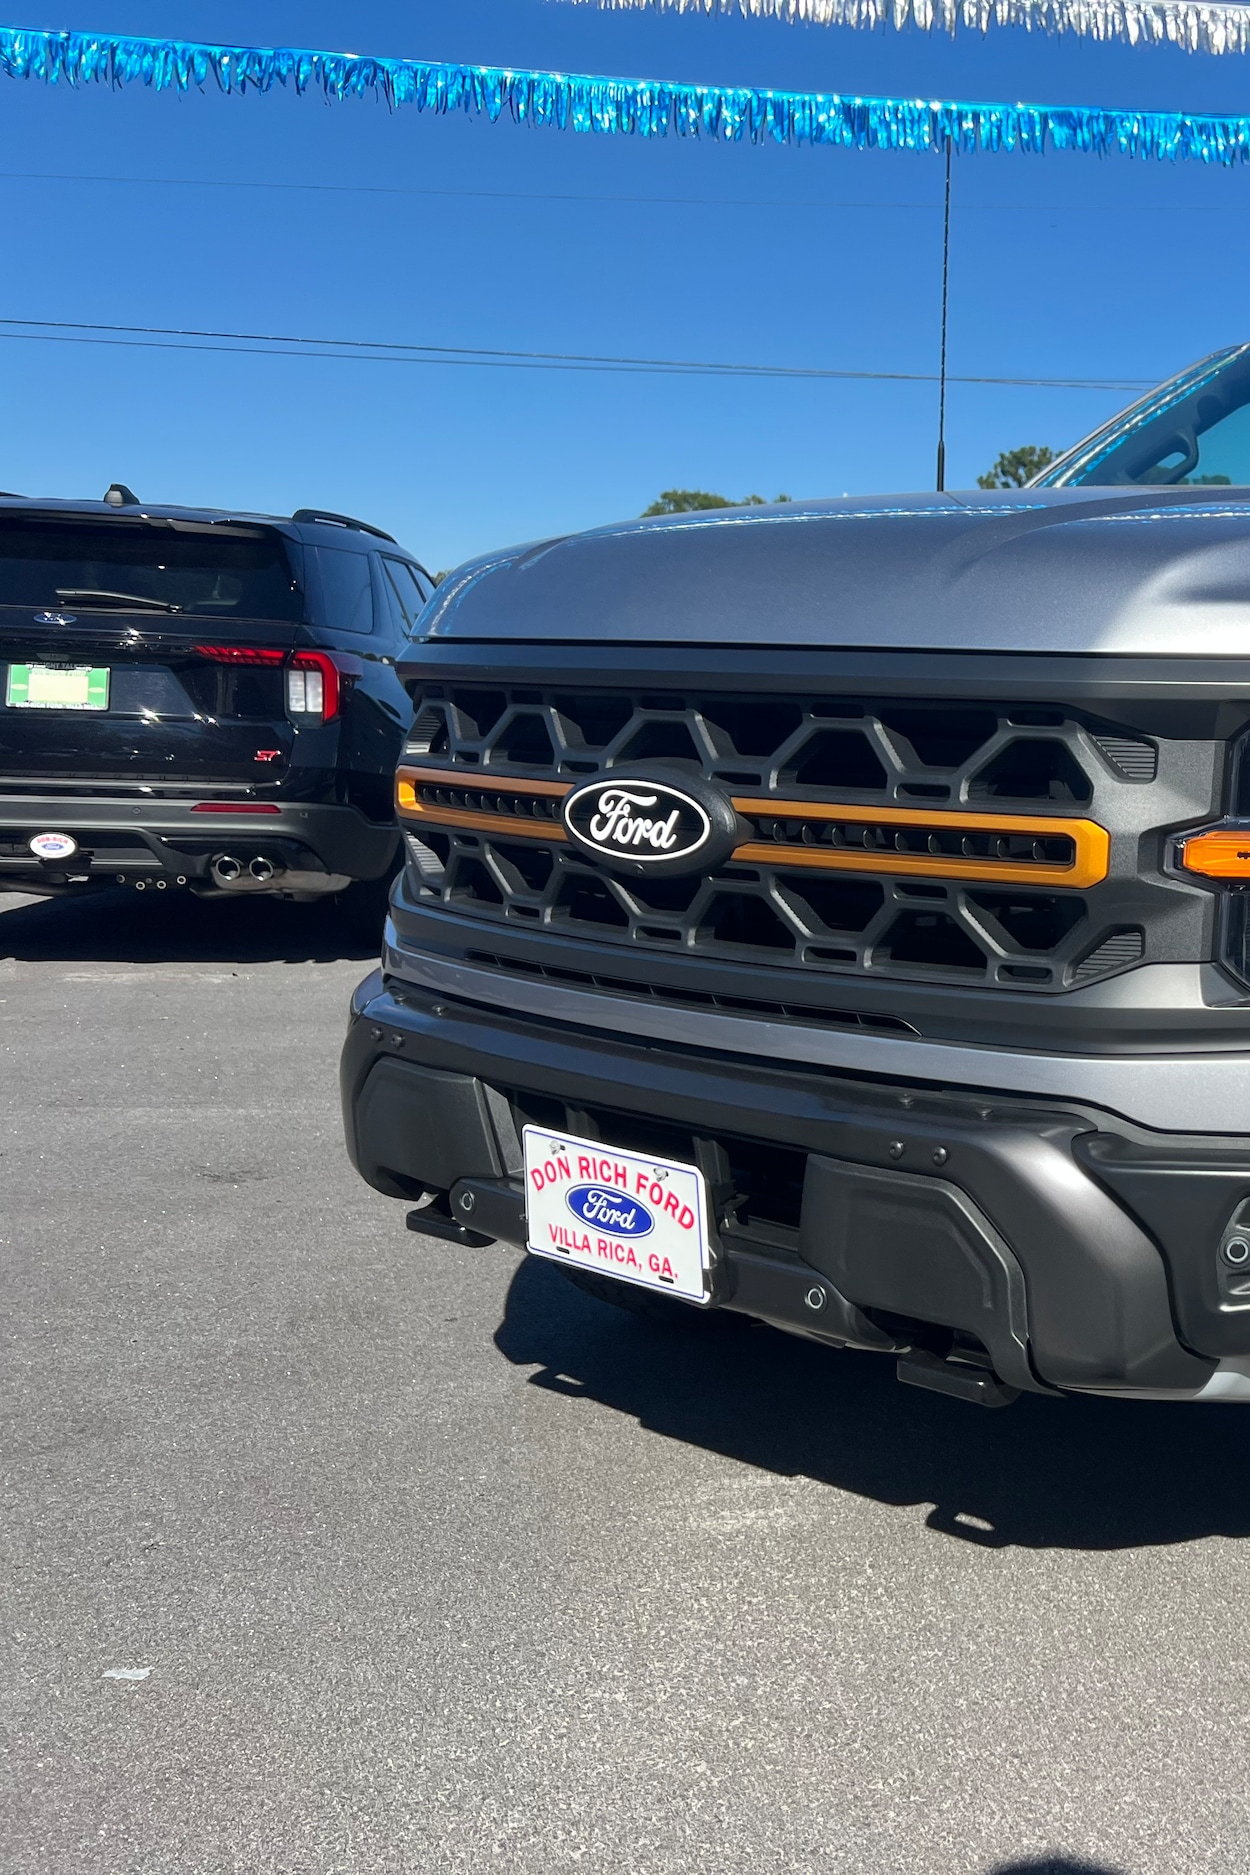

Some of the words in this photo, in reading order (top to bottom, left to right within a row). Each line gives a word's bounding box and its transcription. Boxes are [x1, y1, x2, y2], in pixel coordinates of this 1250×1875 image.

[254, 750, 281, 762] ST
[590, 788, 680, 849] Ford
[530, 1156, 571, 1192] DON
[577, 1155, 628, 1189] RICH
[635, 1173, 696, 1231] FORD
[582, 1189, 637, 1230] Ford
[548, 1223, 592, 1255] VILLA
[597, 1238, 643, 1273] RICA,
[648, 1253, 679, 1279] GA.
